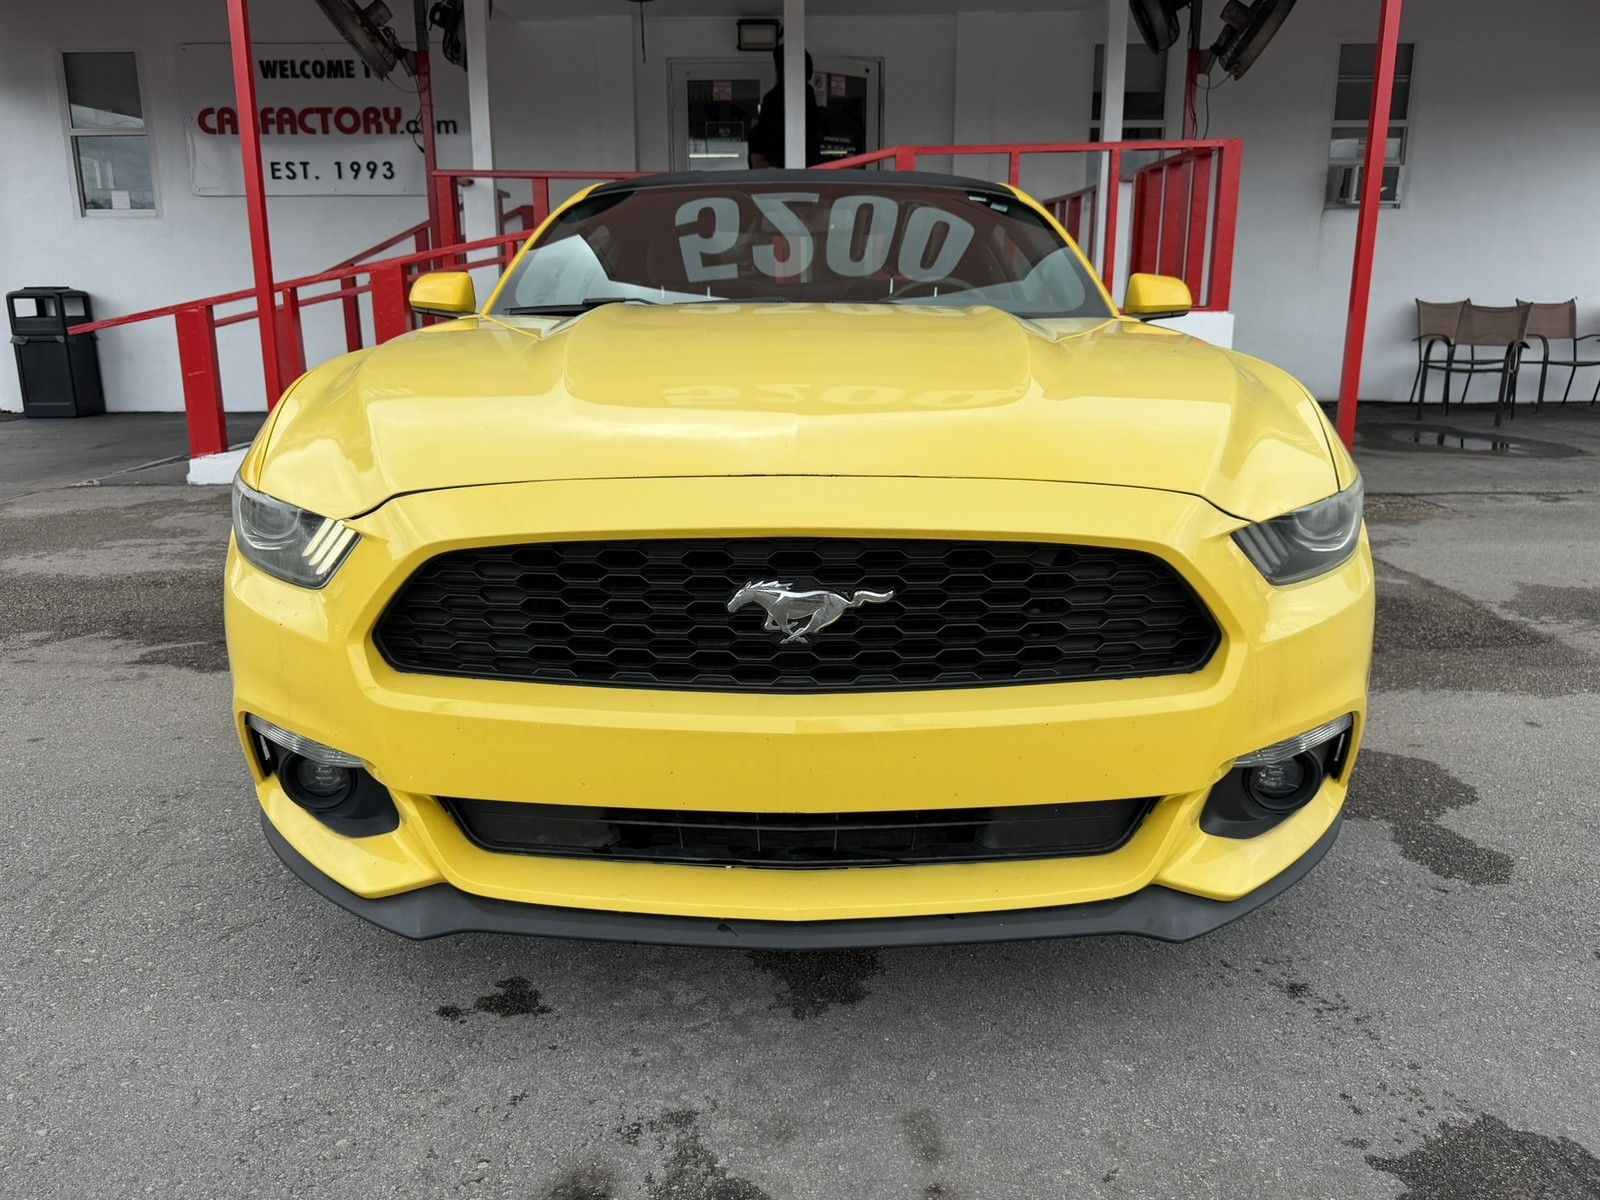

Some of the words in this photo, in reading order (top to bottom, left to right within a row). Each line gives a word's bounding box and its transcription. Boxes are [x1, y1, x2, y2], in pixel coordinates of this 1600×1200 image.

[259, 60, 355, 79] WELCOME
[198, 106, 458, 135] CAFACTORY.cm
[270, 161, 320, 180] EST.
[334, 161, 395, 180] 1993
